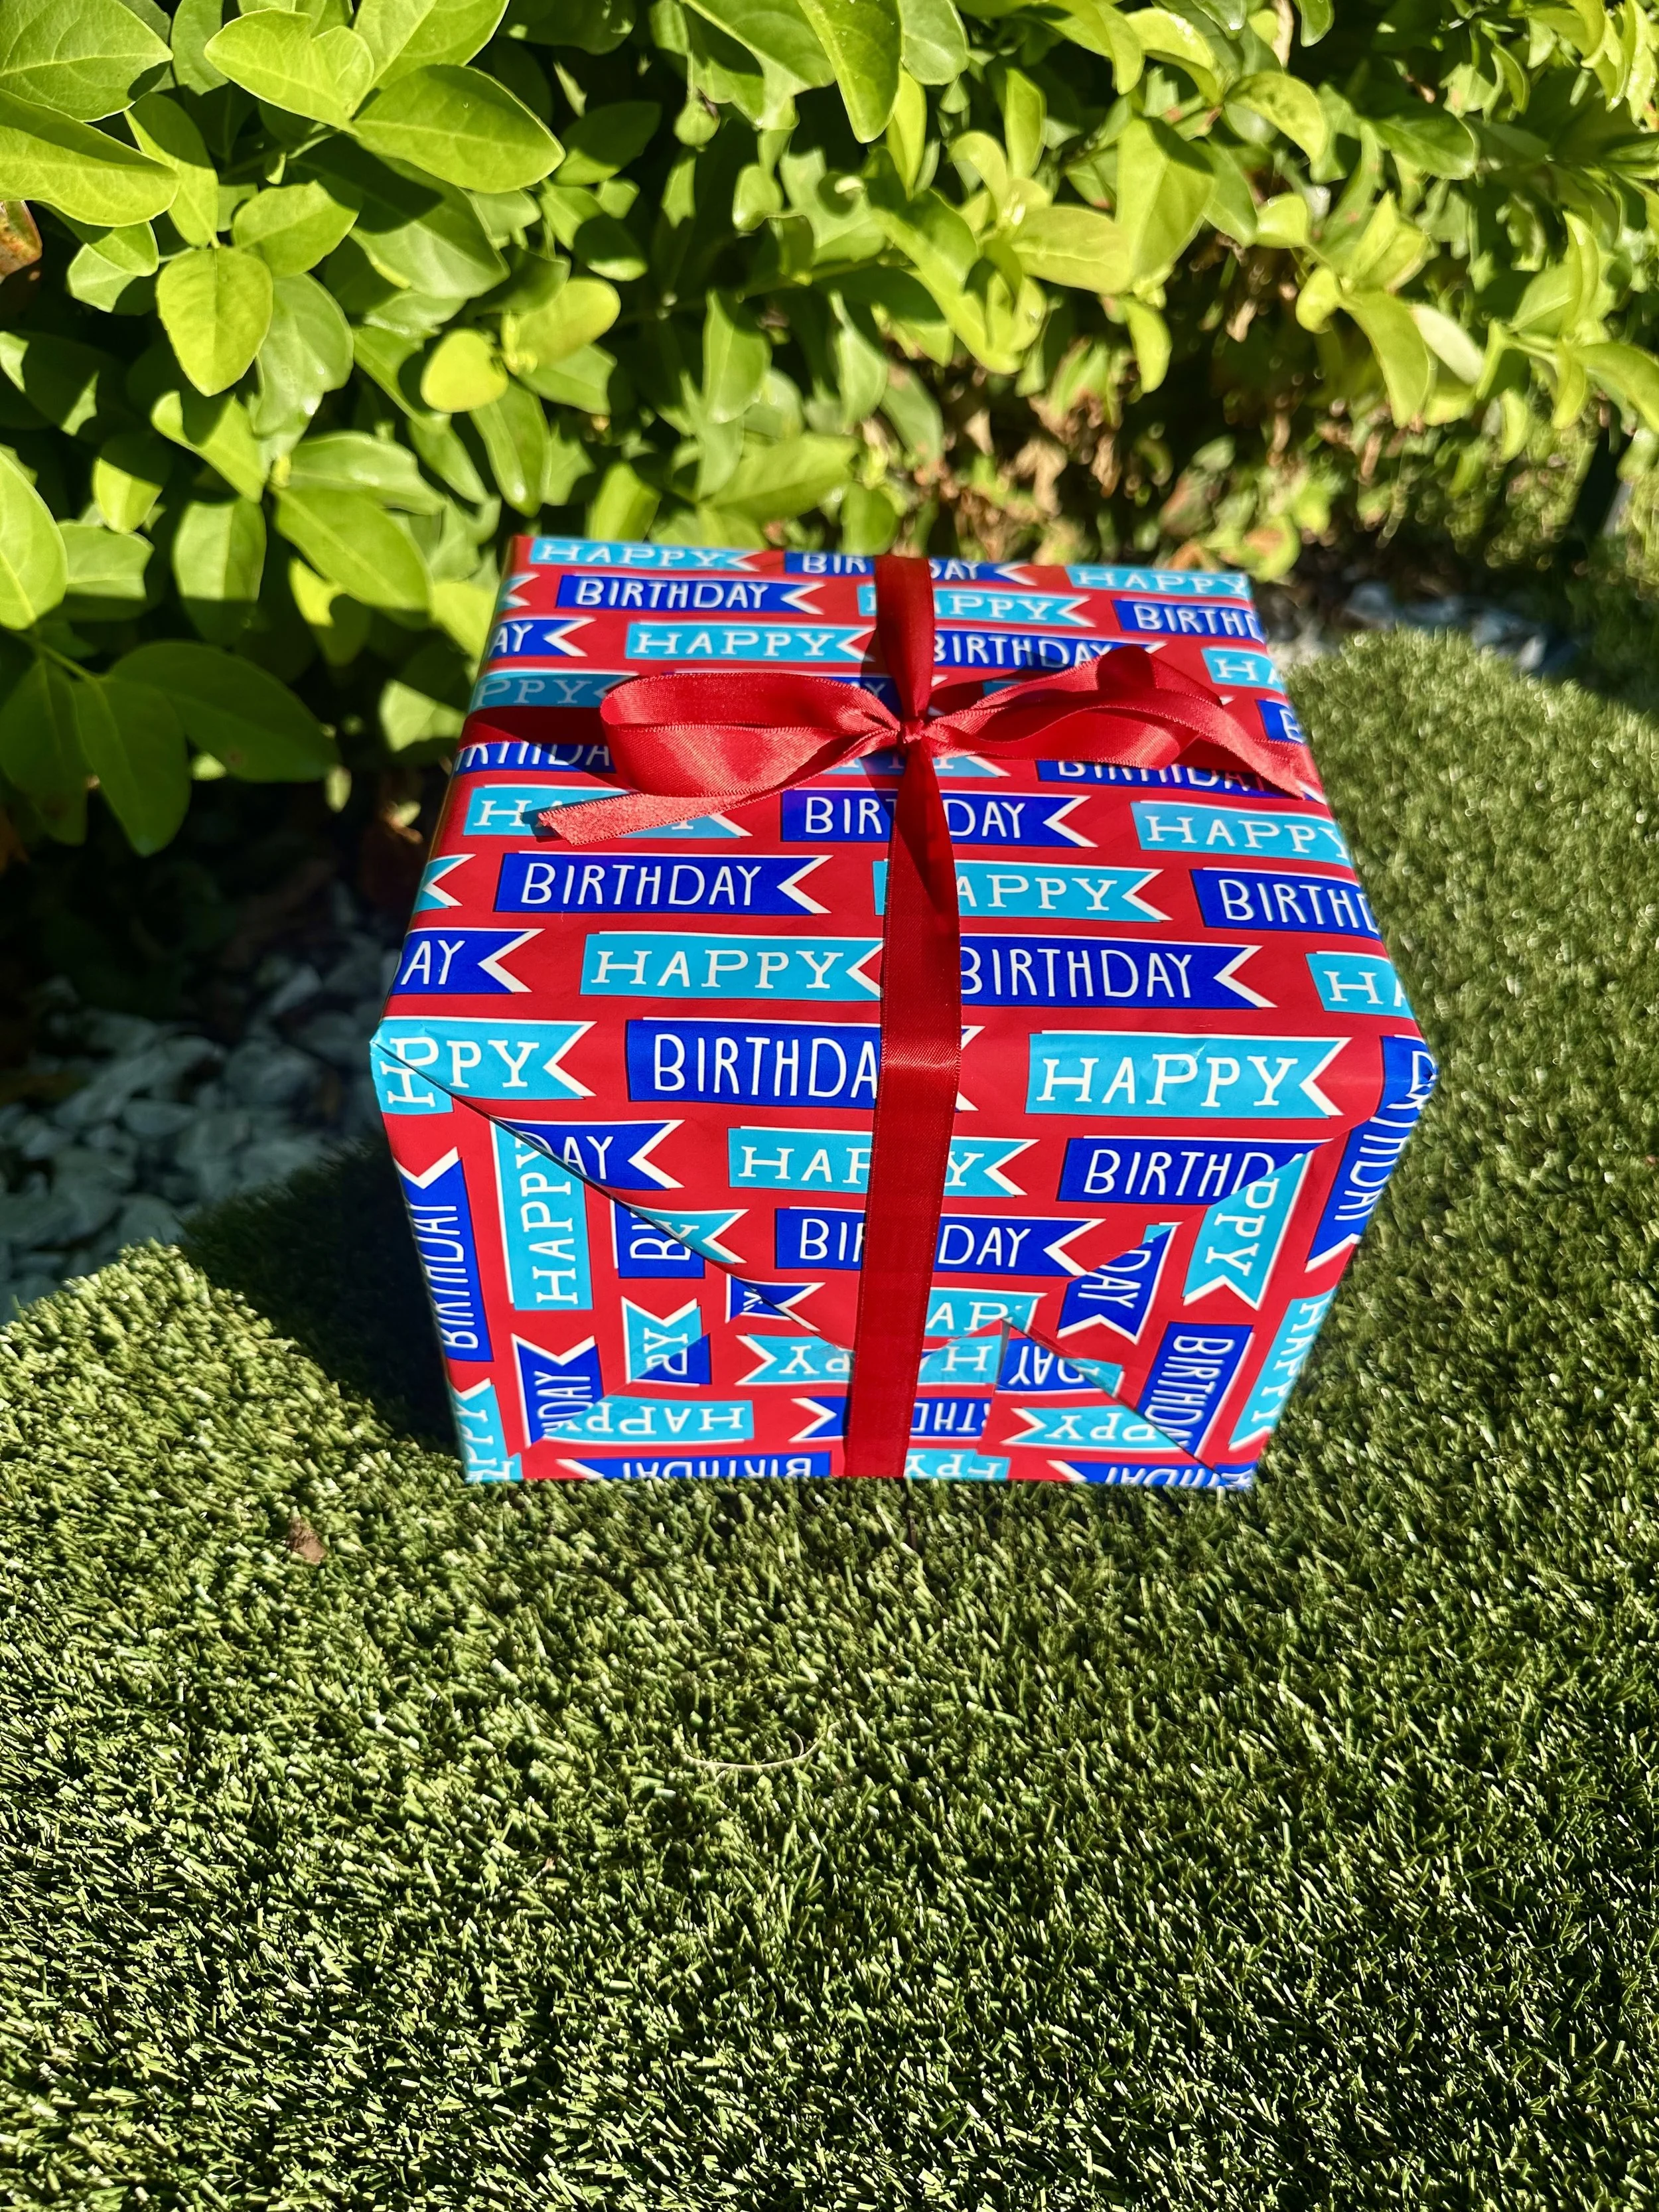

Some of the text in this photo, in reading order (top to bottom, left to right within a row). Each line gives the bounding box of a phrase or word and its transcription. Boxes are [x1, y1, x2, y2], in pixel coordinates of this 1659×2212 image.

[540, 544, 726, 569] HAPPY
[575, 578, 769, 610] BIRTHDAY
[633, 627, 836, 657] HAPPY
[520, 862, 762, 907] BIRTHDAY
[590, 949, 844, 990] HAPPY
[960, 946, 1192, 999] BIRTHDAY
[1036, 1053, 1299, 1107] HAPPY
